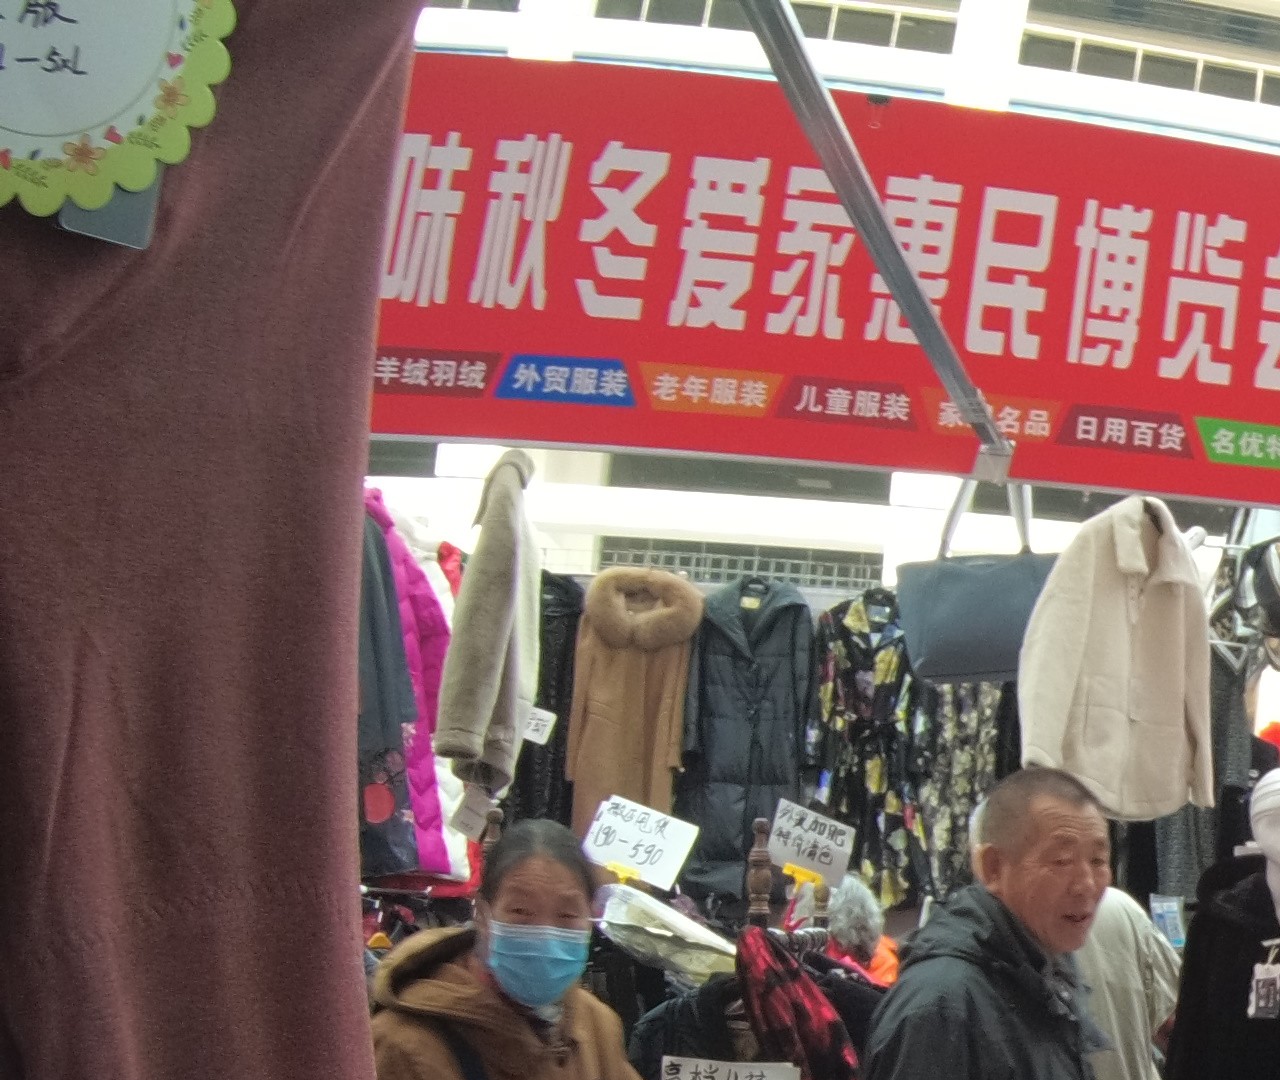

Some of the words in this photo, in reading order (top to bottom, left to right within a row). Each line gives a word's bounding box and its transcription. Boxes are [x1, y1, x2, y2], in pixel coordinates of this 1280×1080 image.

[375, 356, 487, 391] 羊绒羽绒
[513, 363, 628, 399] 外贸服装
[652, 373, 769, 408] 老年服装
[794, 385, 911, 421] 儿童服装
[937, 396, 1052, 438] 家名品
[1074, 416, 1188, 453] 日用百货
